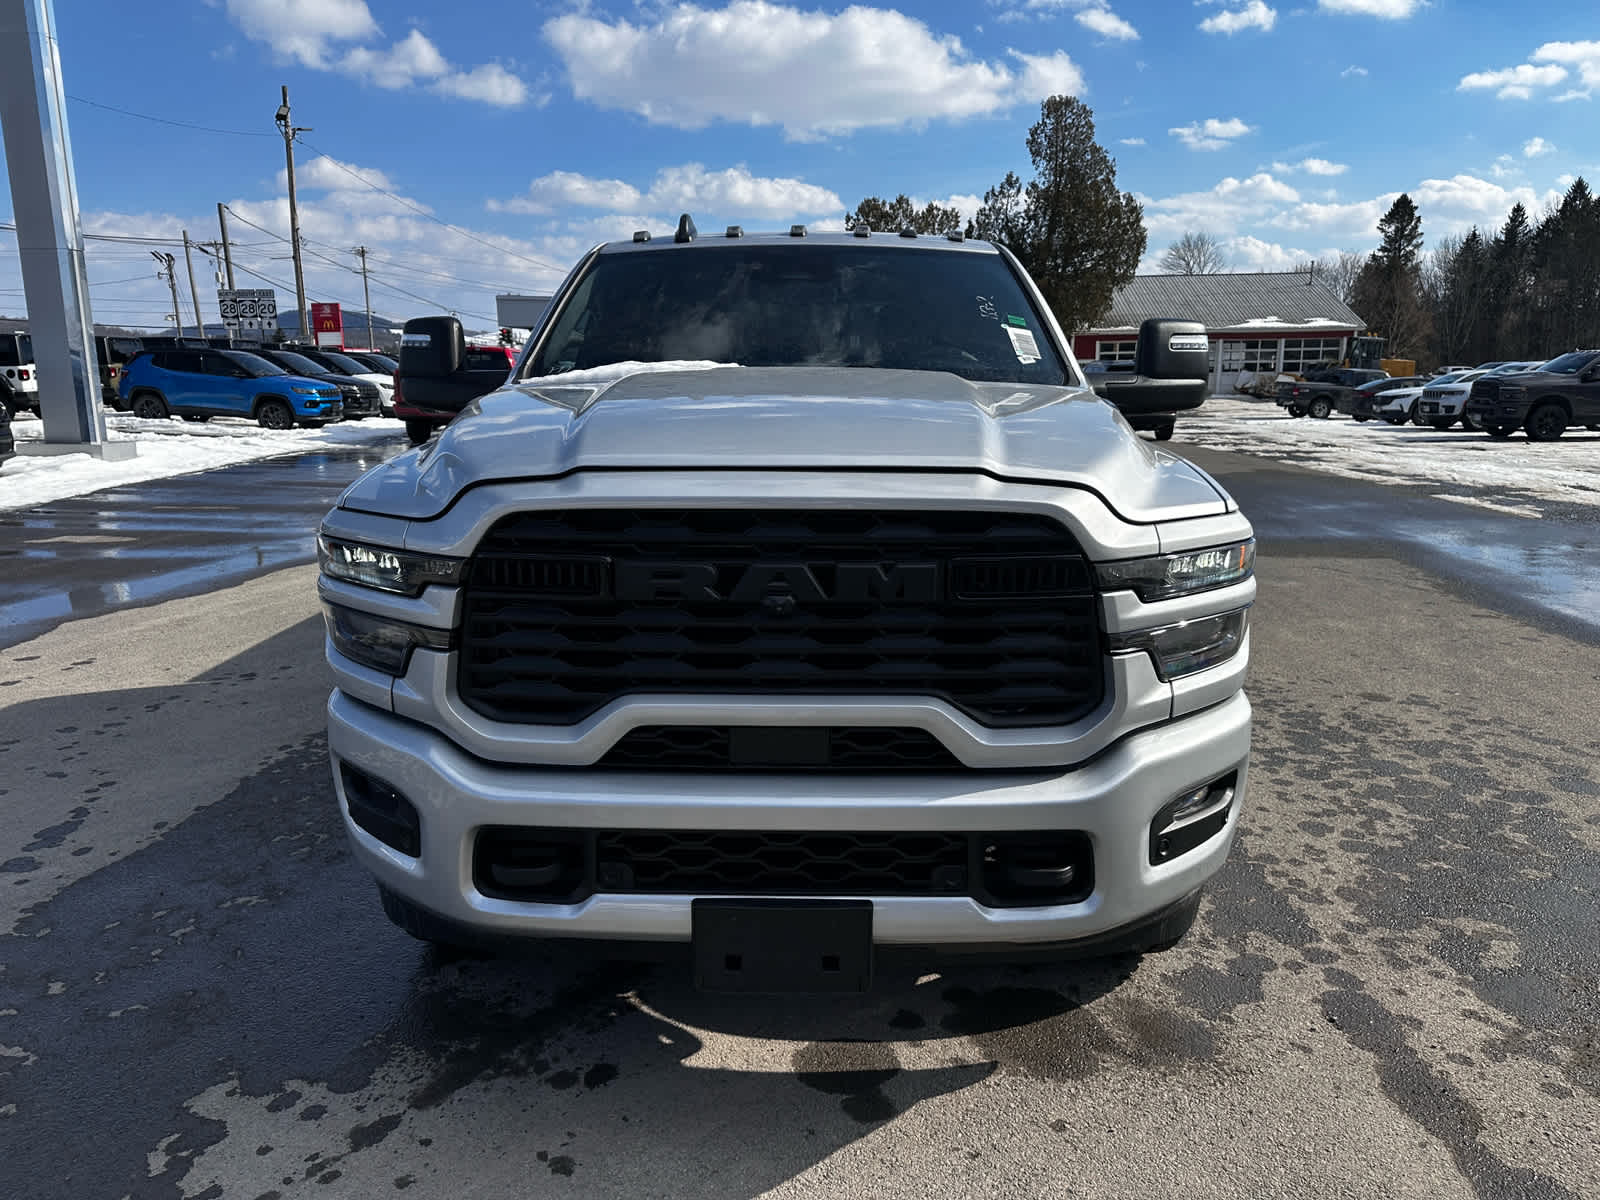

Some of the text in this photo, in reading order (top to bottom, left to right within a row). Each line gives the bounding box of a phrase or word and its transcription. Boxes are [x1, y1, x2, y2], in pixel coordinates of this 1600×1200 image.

[222, 303, 237, 314] 28
[241, 303, 256, 314] 28
[260, 303, 275, 314] 20
[619, 561, 937, 602] RAM
